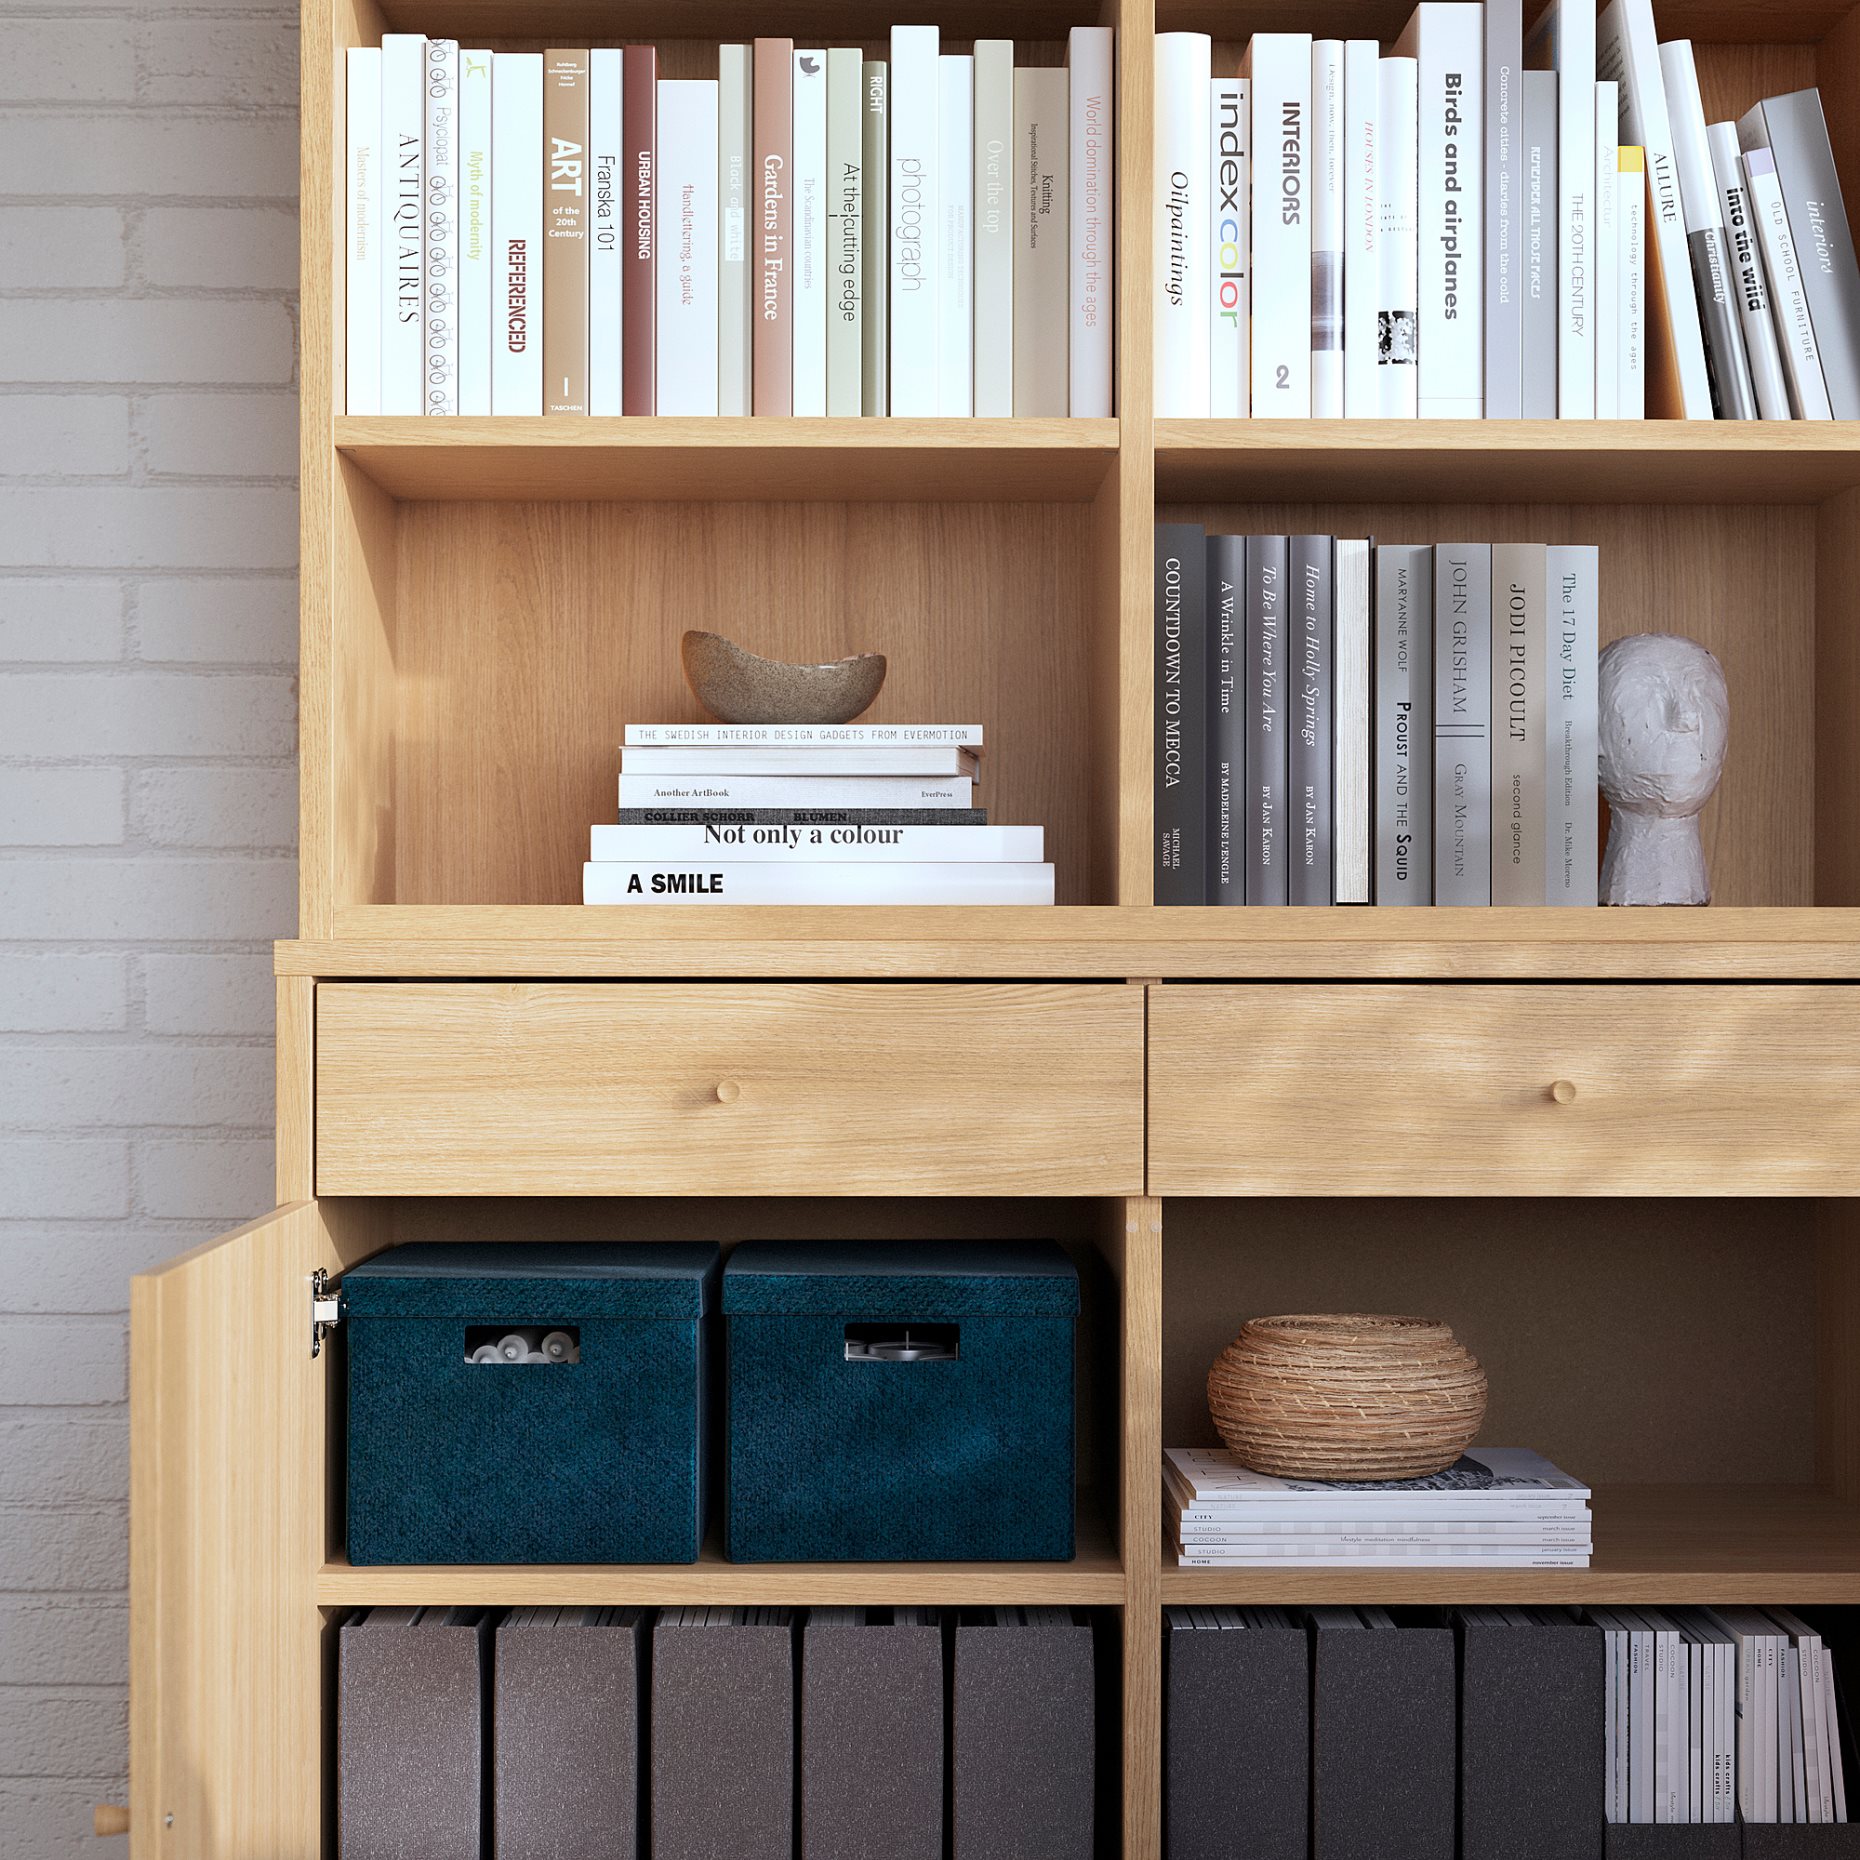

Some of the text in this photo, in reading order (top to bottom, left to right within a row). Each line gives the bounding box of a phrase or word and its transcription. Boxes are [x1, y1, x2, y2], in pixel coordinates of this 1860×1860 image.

[432, 107, 452, 166] Psyclopat
[869, 76, 883, 114] RIGHT
[356, 190, 370, 202] of
[467, 151, 484, 260] Myth of modernity
[551, 137, 582, 196] ART
[552, 206, 580, 215] of the
[597, 155, 616, 251] Franska 101
[638, 151, 650, 260] URBAN HOUSING
[730, 155, 742, 260] Black and white
[983, 140, 1004, 234] Over the top
[1028, 123, 1038, 249] Inspirational Textures and Surfaces
[1038, 174, 1054, 214] Knitting
[1081, 96, 1102, 327] World domination through the ages
[1219, 93, 1244, 328] index color
[1282, 101, 1301, 225] INTERIORS
[1364, 120, 1374, 253] HOUSES IN LONDON
[1440, 73, 1462, 320] Birds and airplanes
[1499, 66, 1511, 303] Concrete cities diaries from the cold
[1653, 152, 1677, 224] ALLURE
[394, 133, 420, 324] ANTIQUAIRES
[548, 230, 584, 239] Century
[555, 218, 577, 226] 20th
[764, 154, 783, 320] Gardens in France
[803, 178, 815, 289] The Scandinavian countries
[839, 163, 860, 322] At the cutting edge
[895, 158, 927, 291] photograph
[1165, 171, 1189, 306] Oilpaintings
[1571, 193, 1584, 336] THE CENTURY
[1704, 231, 1726, 304] Christianity
[1725, 187, 1754, 263] into the
[1805, 200, 1834, 274] interiors
[508, 239, 526, 353] REFERENCED
[679, 275, 694, 305] guide
[1629, 204, 1639, 370] technology through the ages
[1777, 235, 1814, 362] SCHOOL FURNITURE
[1275, 364, 1290, 389] 2
[1221, 580, 1234, 714] A Wrinkle in Time
[1262, 566, 1277, 732] To Be Where You Are
[1301, 564, 1320, 747] Home to Holly Springs
[1397, 568, 1407, 673] MARYANNE WOLF
[1449, 560, 1467, 713] JOHN GRISHAM
[1509, 583, 1525, 742] JODI PICOULT
[1560, 573, 1576, 700] The 17 Day Diet
[1165, 558, 1180, 788] COUNTDOWN TO MECCA
[639, 730, 968, 740] THE SWEDISH INTERIOR DESIGN GADGETS FROM EVERMOTION
[1563, 720, 1573, 806] Breakthrough Edition
[644, 812, 755, 822] COLLIER SCHORR
[654, 789, 730, 797] Another ArtBook
[703, 825, 904, 849] Not only a colour
[793, 812, 847, 822] BLUMEN
[1396, 764, 1408, 827] AND THE
[1511, 774, 1523, 864] second glance
[627, 873, 724, 894] A SMILE
[1162, 832, 1170, 867] SAVAGE
[1172, 828, 1180, 870] MICHAEL
[1564, 822, 1573, 888] Dr. Mike Moreno
